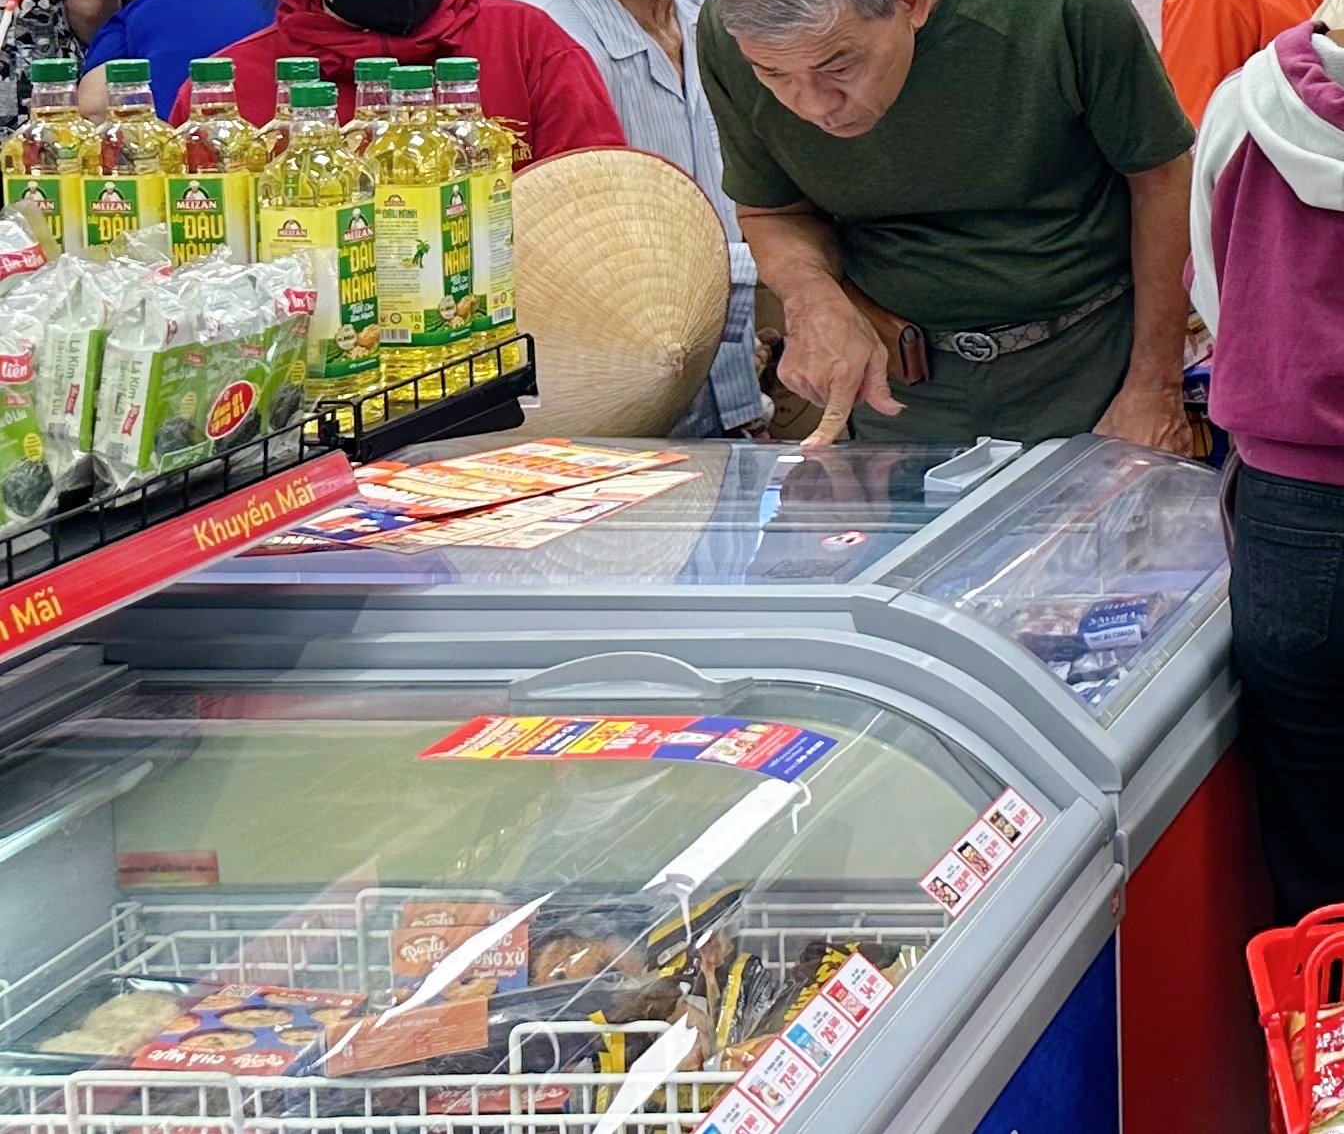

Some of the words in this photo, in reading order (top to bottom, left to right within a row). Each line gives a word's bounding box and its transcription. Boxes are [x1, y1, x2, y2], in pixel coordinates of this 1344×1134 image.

[92, 201, 132, 211] MEIZAN
[176, 199, 217, 210] MEIZAN
[183, 212, 225, 239] ĐẬU
[343, 228, 374, 242] MEIZAN
[349, 242, 376, 273] ĐẬU
[341, 272, 377, 305] NÀNH
[192, 493, 275, 551] Khuyến
[275, 476, 317, 515] Mãi
[10, 587, 63, 633] Mãi
